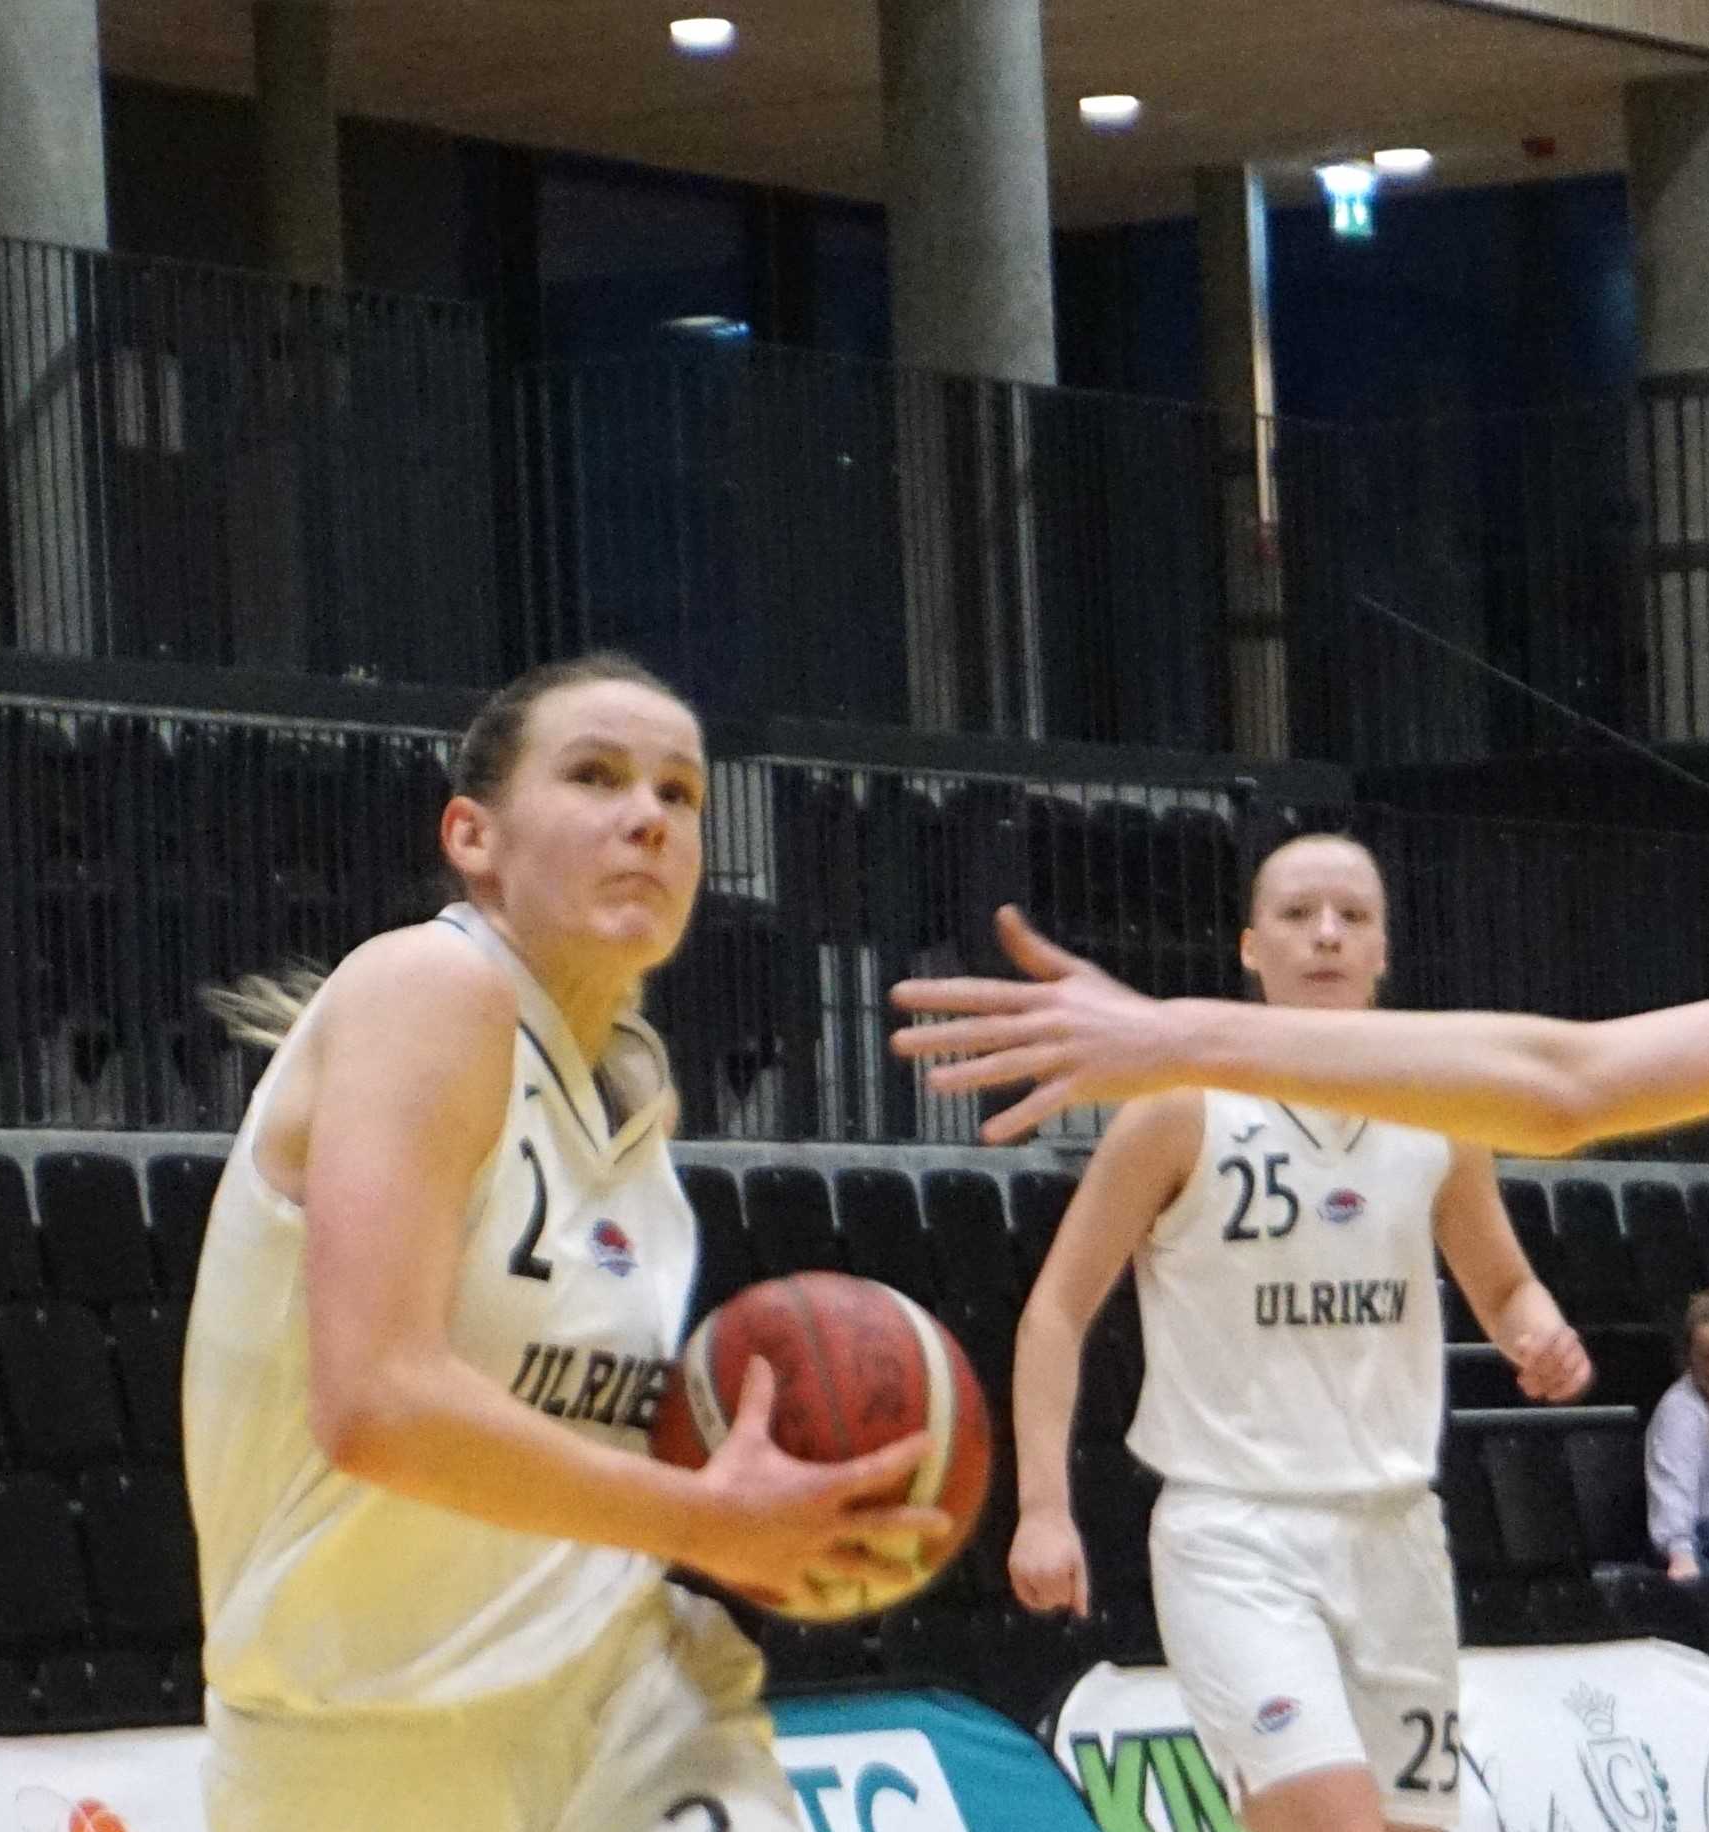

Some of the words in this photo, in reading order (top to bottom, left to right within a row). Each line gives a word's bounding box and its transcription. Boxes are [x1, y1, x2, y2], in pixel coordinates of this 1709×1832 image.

[508, 1137, 552, 1282] 2
[1217, 1152, 1300, 1241] 25
[1395, 1708, 1459, 1792] 25
